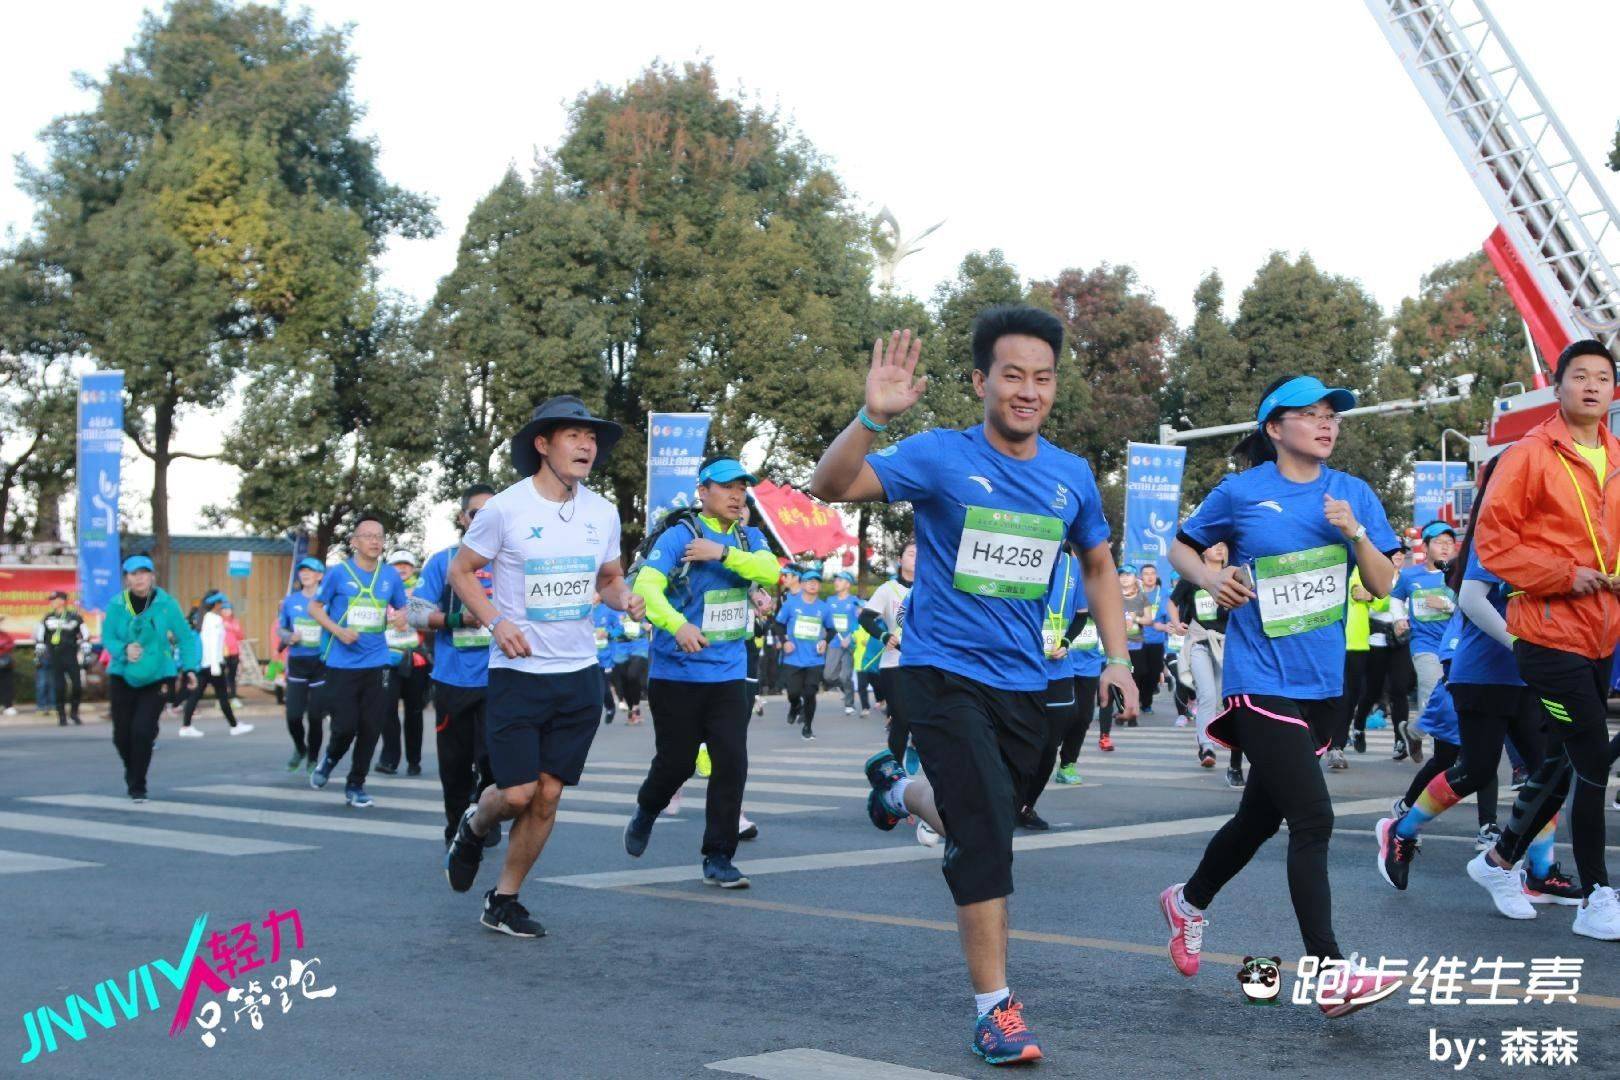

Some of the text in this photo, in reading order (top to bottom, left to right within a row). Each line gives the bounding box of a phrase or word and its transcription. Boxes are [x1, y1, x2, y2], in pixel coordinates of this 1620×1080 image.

[972, 541, 1043, 568] H4258
[530, 579, 590, 597] A10267
[1272, 575, 1337, 605] H1243
[710, 607, 744, 622] H5870
